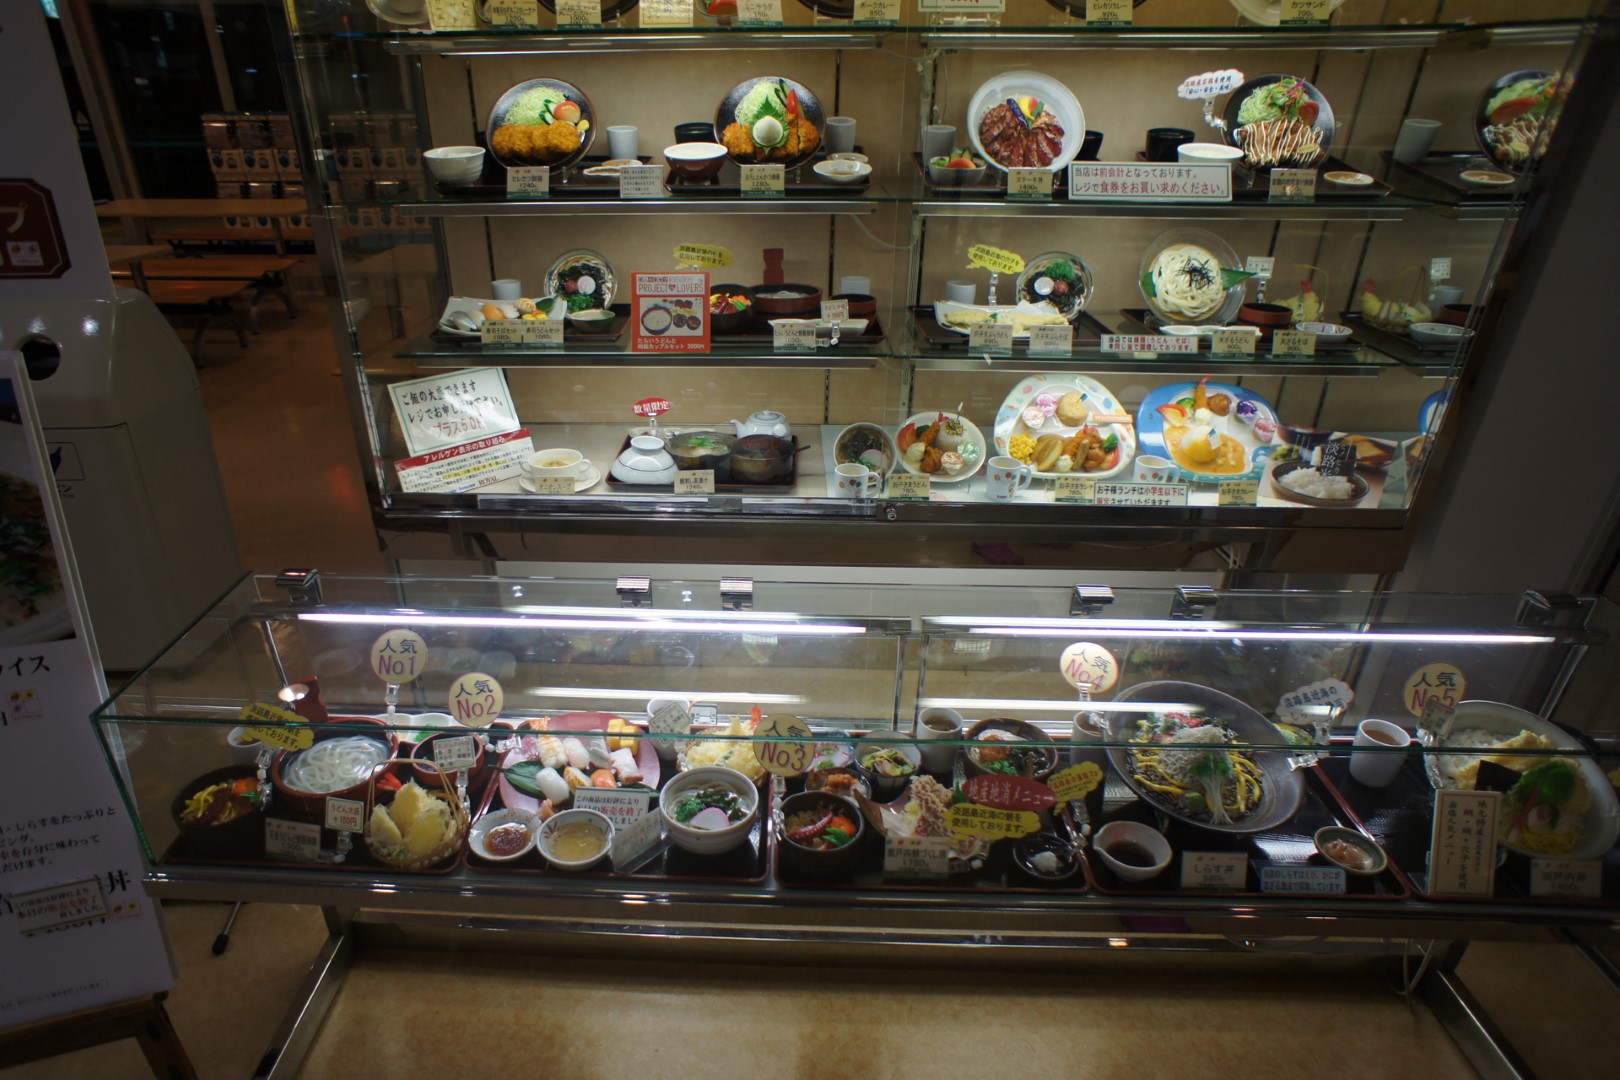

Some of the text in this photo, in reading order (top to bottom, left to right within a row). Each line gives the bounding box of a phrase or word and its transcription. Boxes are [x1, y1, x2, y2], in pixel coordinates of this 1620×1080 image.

[1074, 166, 1198, 180] 当店は前会計となっております。
[1074, 180, 1227, 196] レジで食券をお買い求めください。
[638, 284, 704, 294] PROJECT LOVERS
[632, 400, 671, 416] 数量限定
[1096, 485, 1186, 497] お子様ランチは小学生以下に
[379, 639, 418, 656] 人気
[0, 655, 51, 676] イス
[378, 656, 416, 677] No1
[1072, 649, 1111, 677] 人気
[1066, 661, 1107, 693] No4
[1412, 671, 1457, 689] 人気
[455, 680, 494, 700] 人気
[457, 694, 499, 721] No2
[761, 742, 807, 772] No3
[967, 778, 1055, 806] 地産地消メニュー
[0, 806, 116, 835] ・しらすをたっぷりと
[0, 856, 54, 874] だけます。
[1193, 864, 1236, 876] しらす丼
[105, 870, 133, 896] 丼
